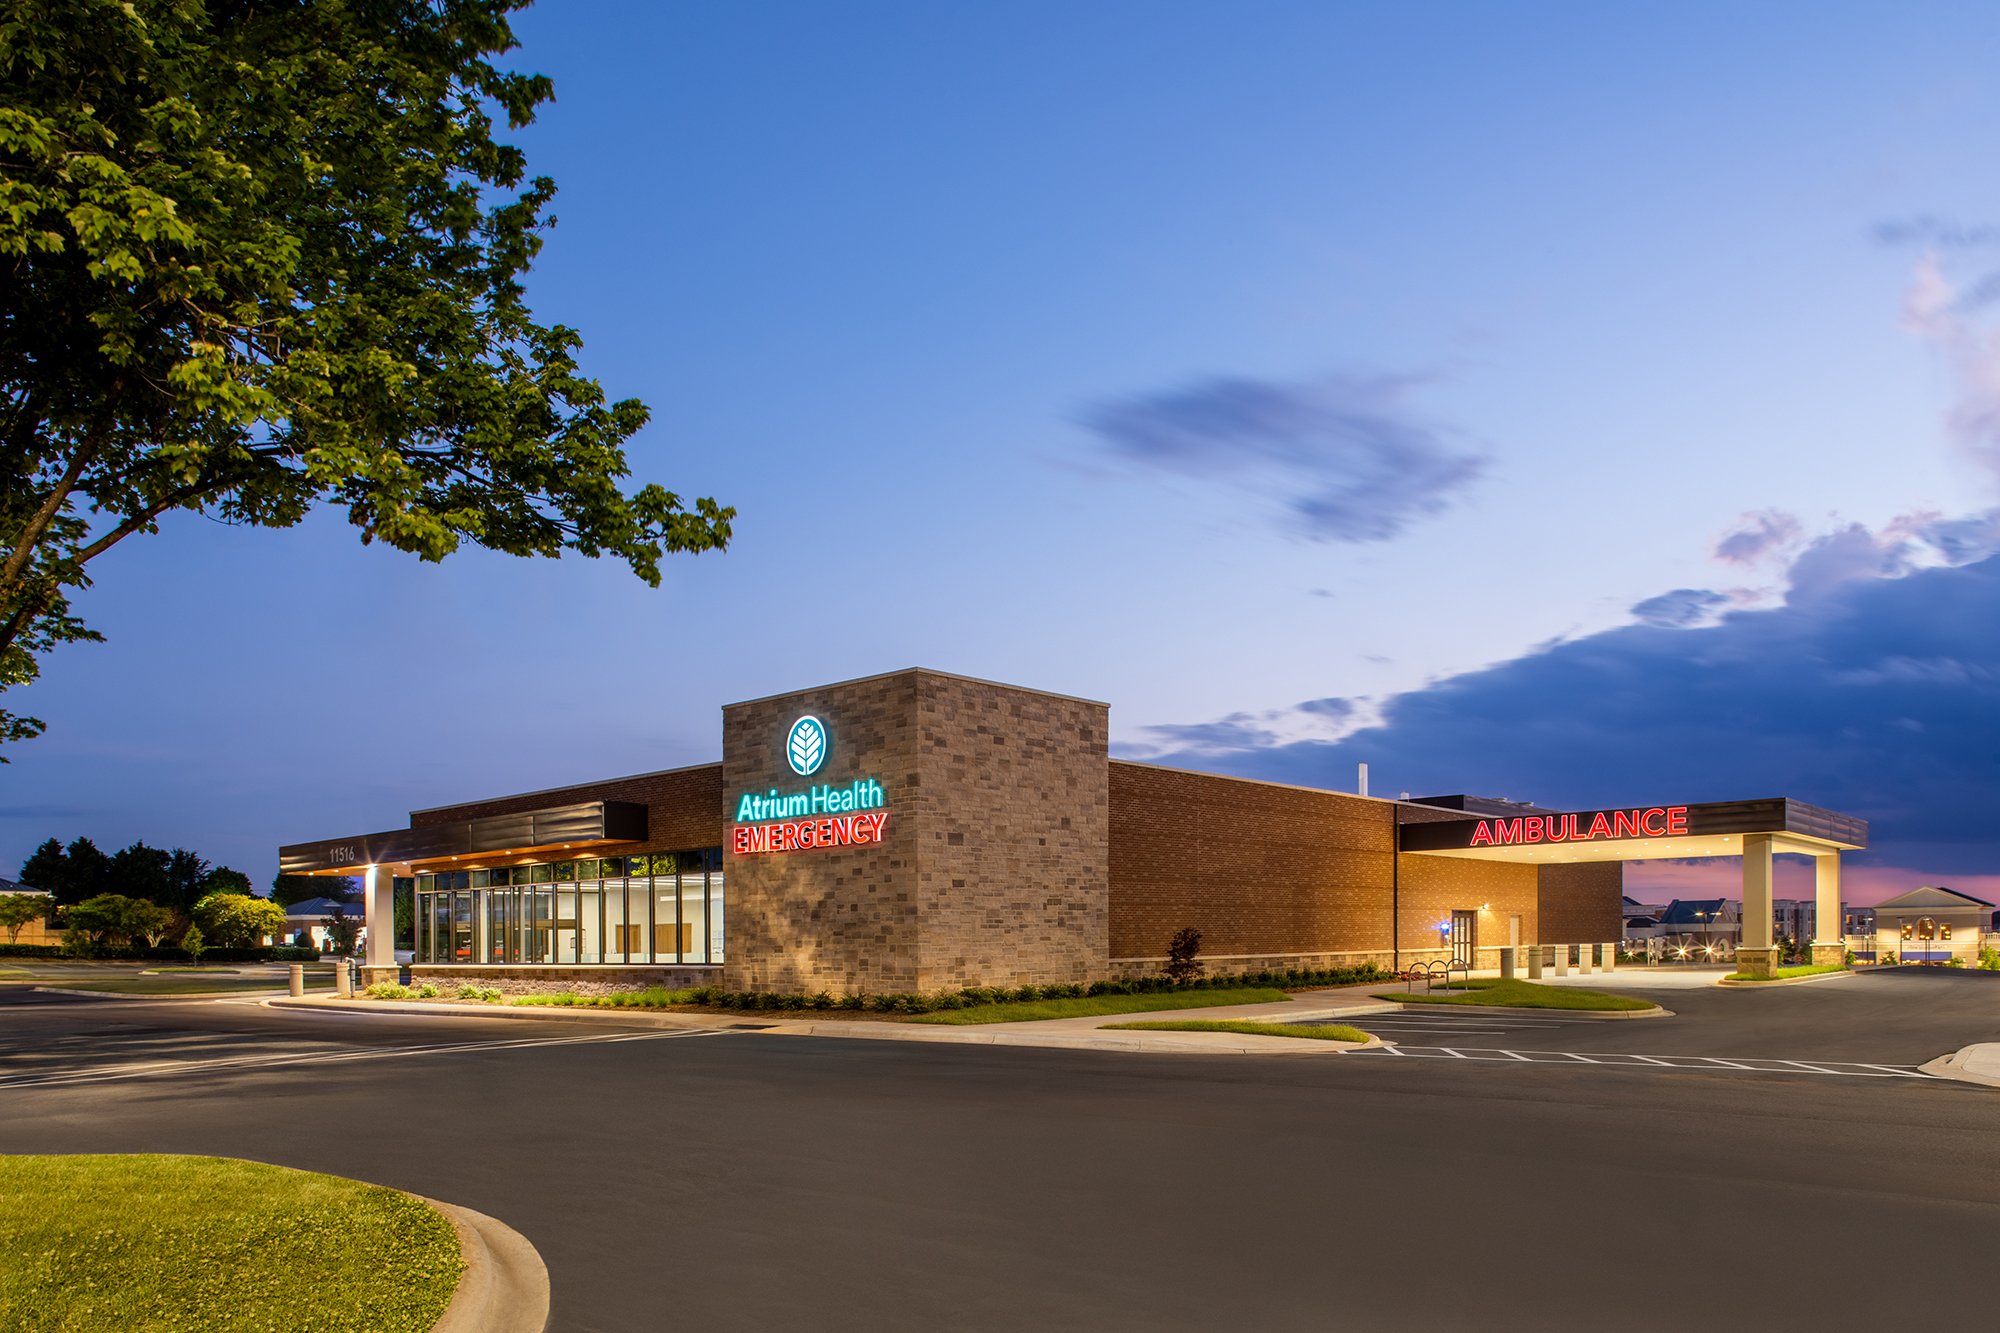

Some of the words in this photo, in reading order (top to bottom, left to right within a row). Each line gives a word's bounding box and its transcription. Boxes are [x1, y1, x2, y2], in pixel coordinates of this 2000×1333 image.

[738, 789, 808, 822] Atrium
[811, 779, 884, 813] Health
[733, 812, 888, 854] EMERGENCY
[1470, 806, 1688, 846] AMBULANCE
[330, 846, 355, 863] 11516
